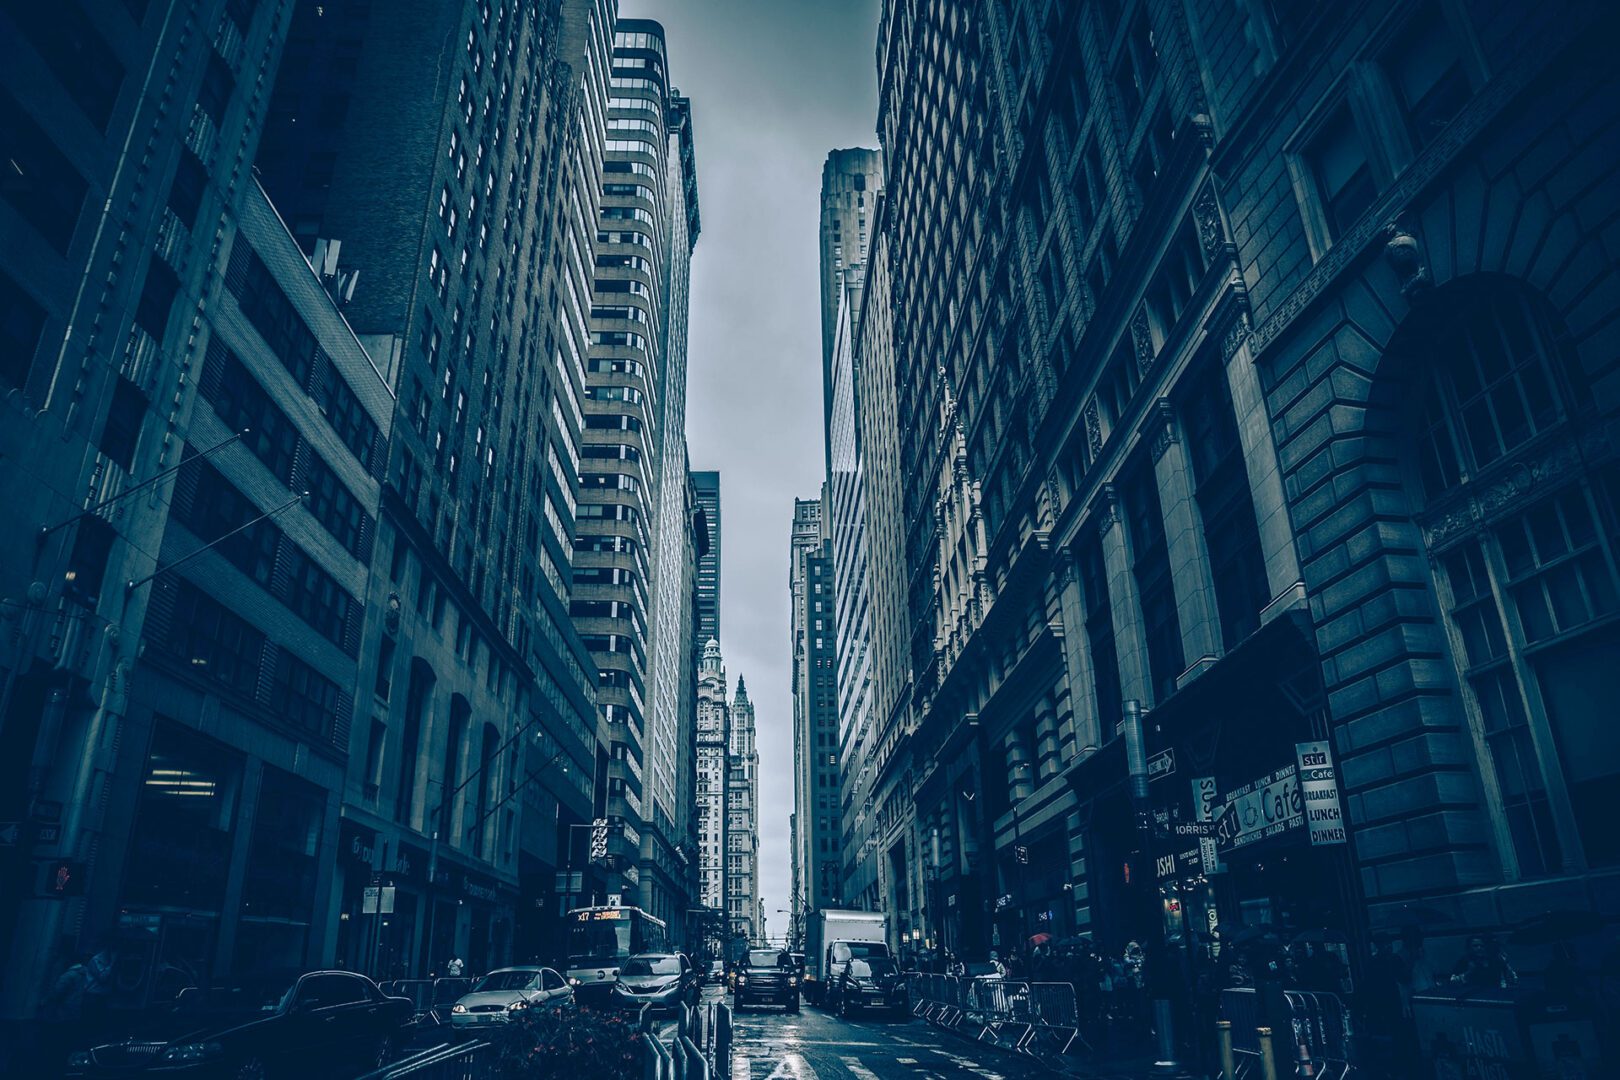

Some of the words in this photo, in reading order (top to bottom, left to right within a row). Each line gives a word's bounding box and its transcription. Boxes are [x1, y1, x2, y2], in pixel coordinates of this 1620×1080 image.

[1303, 753, 1325, 765] stir
[1275, 764, 1295, 781] DINNE
[1310, 769, 1333, 780] Café
[1304, 789, 1337, 801] BREAKFAST
[1262, 782, 1302, 823] Café
[1309, 808, 1340, 821] LUNCH
[1265, 822, 1285, 837] SALADS
[1288, 816, 1303, 829] PAST
[1311, 828, 1345, 843] DINNER
